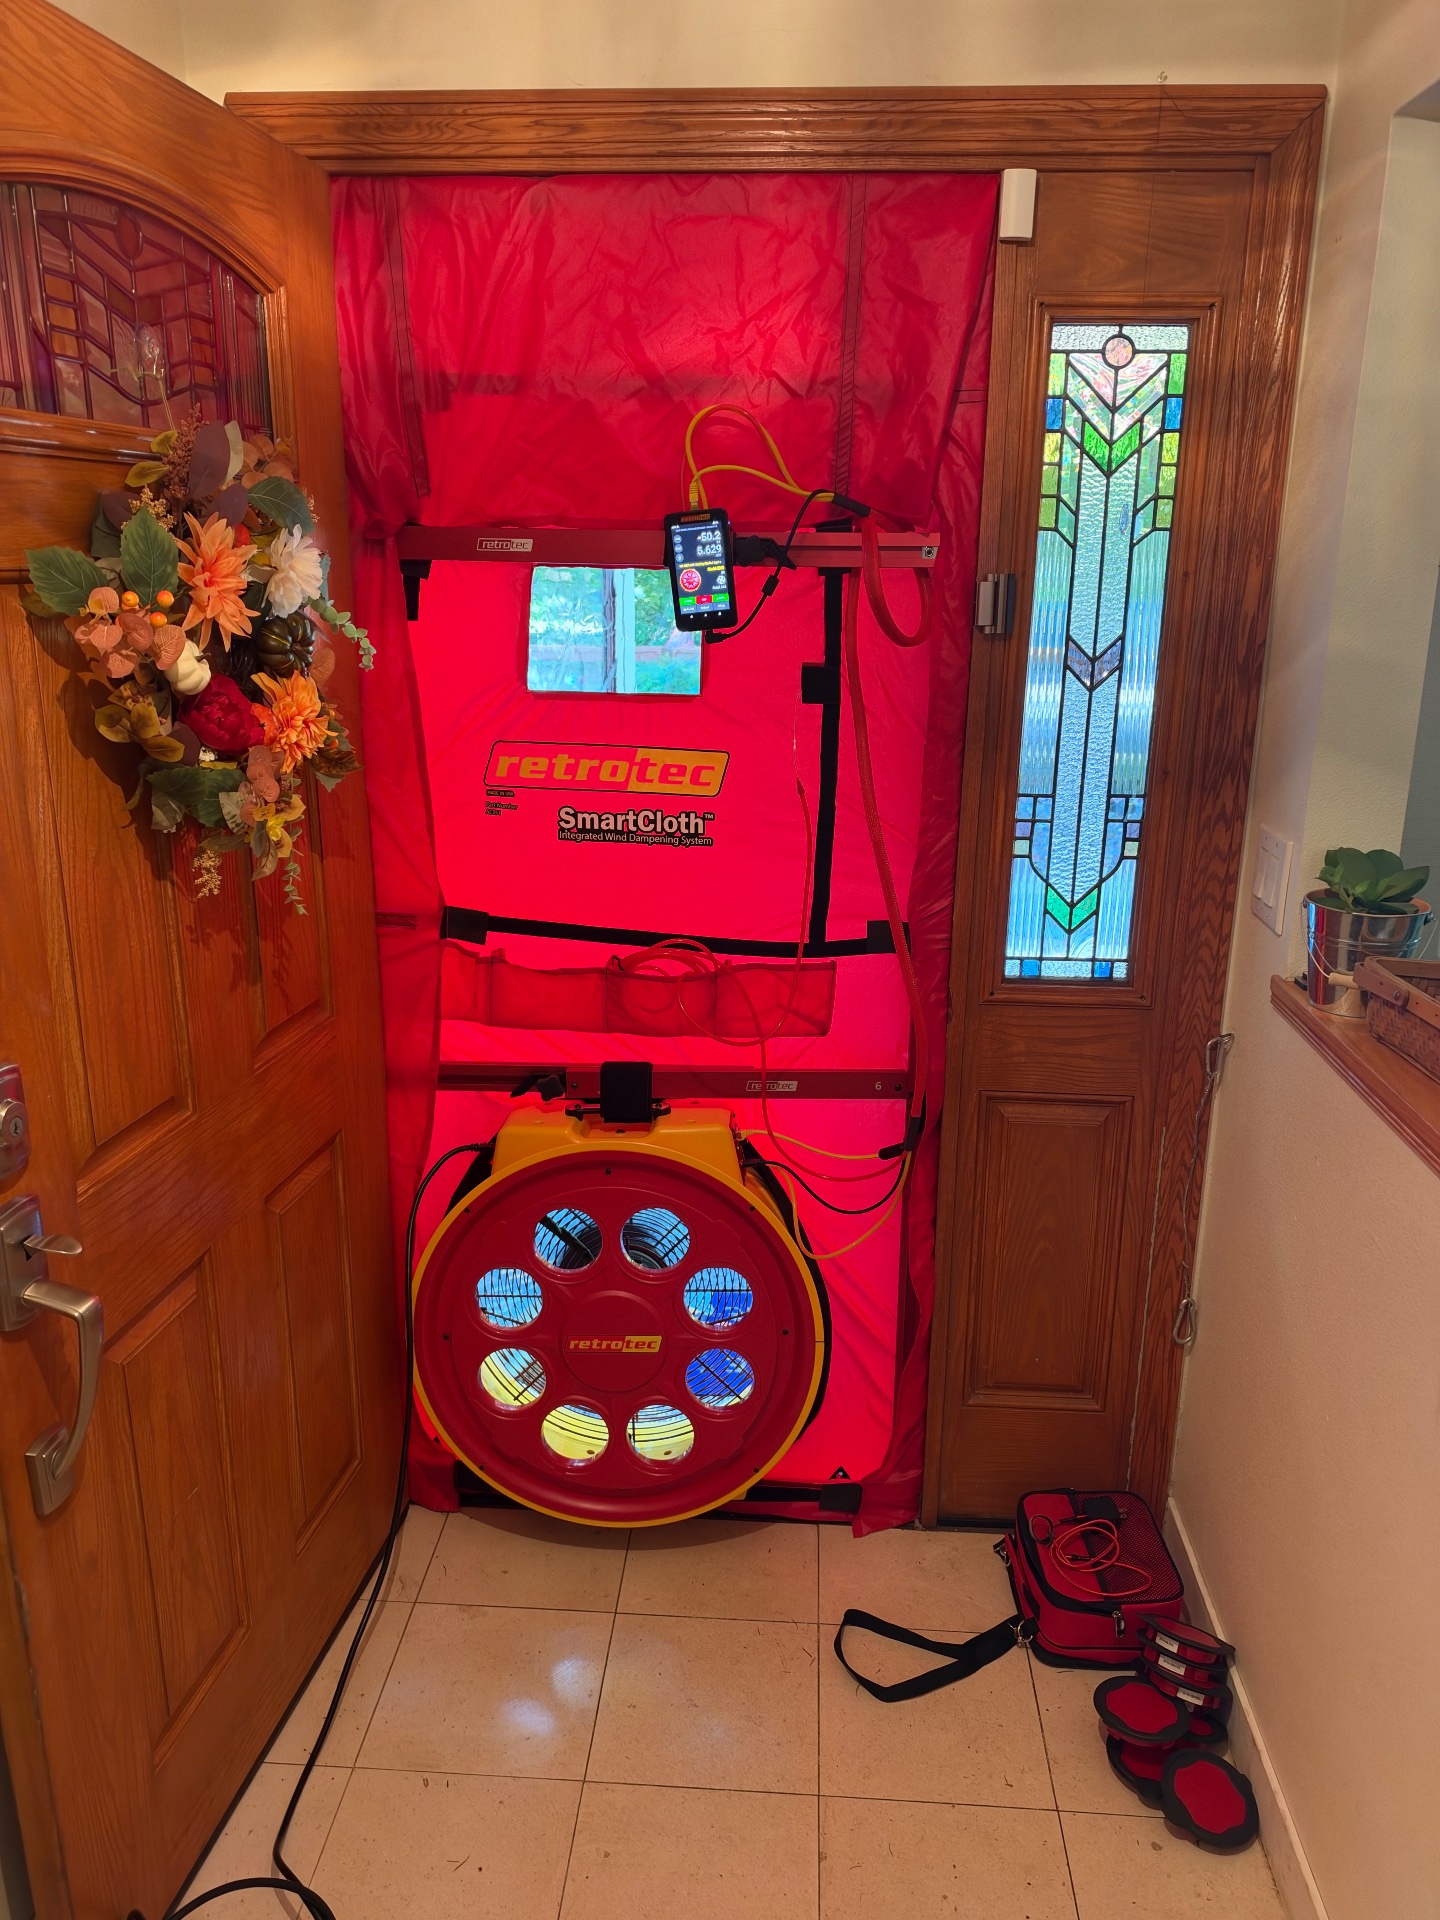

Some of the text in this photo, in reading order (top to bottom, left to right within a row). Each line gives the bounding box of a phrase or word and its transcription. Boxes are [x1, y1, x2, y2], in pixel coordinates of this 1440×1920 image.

[482, 540, 529, 550] retrotec
[495, 753, 716, 787] retrotec
[559, 830, 712, 847] Integrated Wind Dampening System
[875, 1081, 882, 1090] 6
[569, 1339, 657, 1349] retrotec
